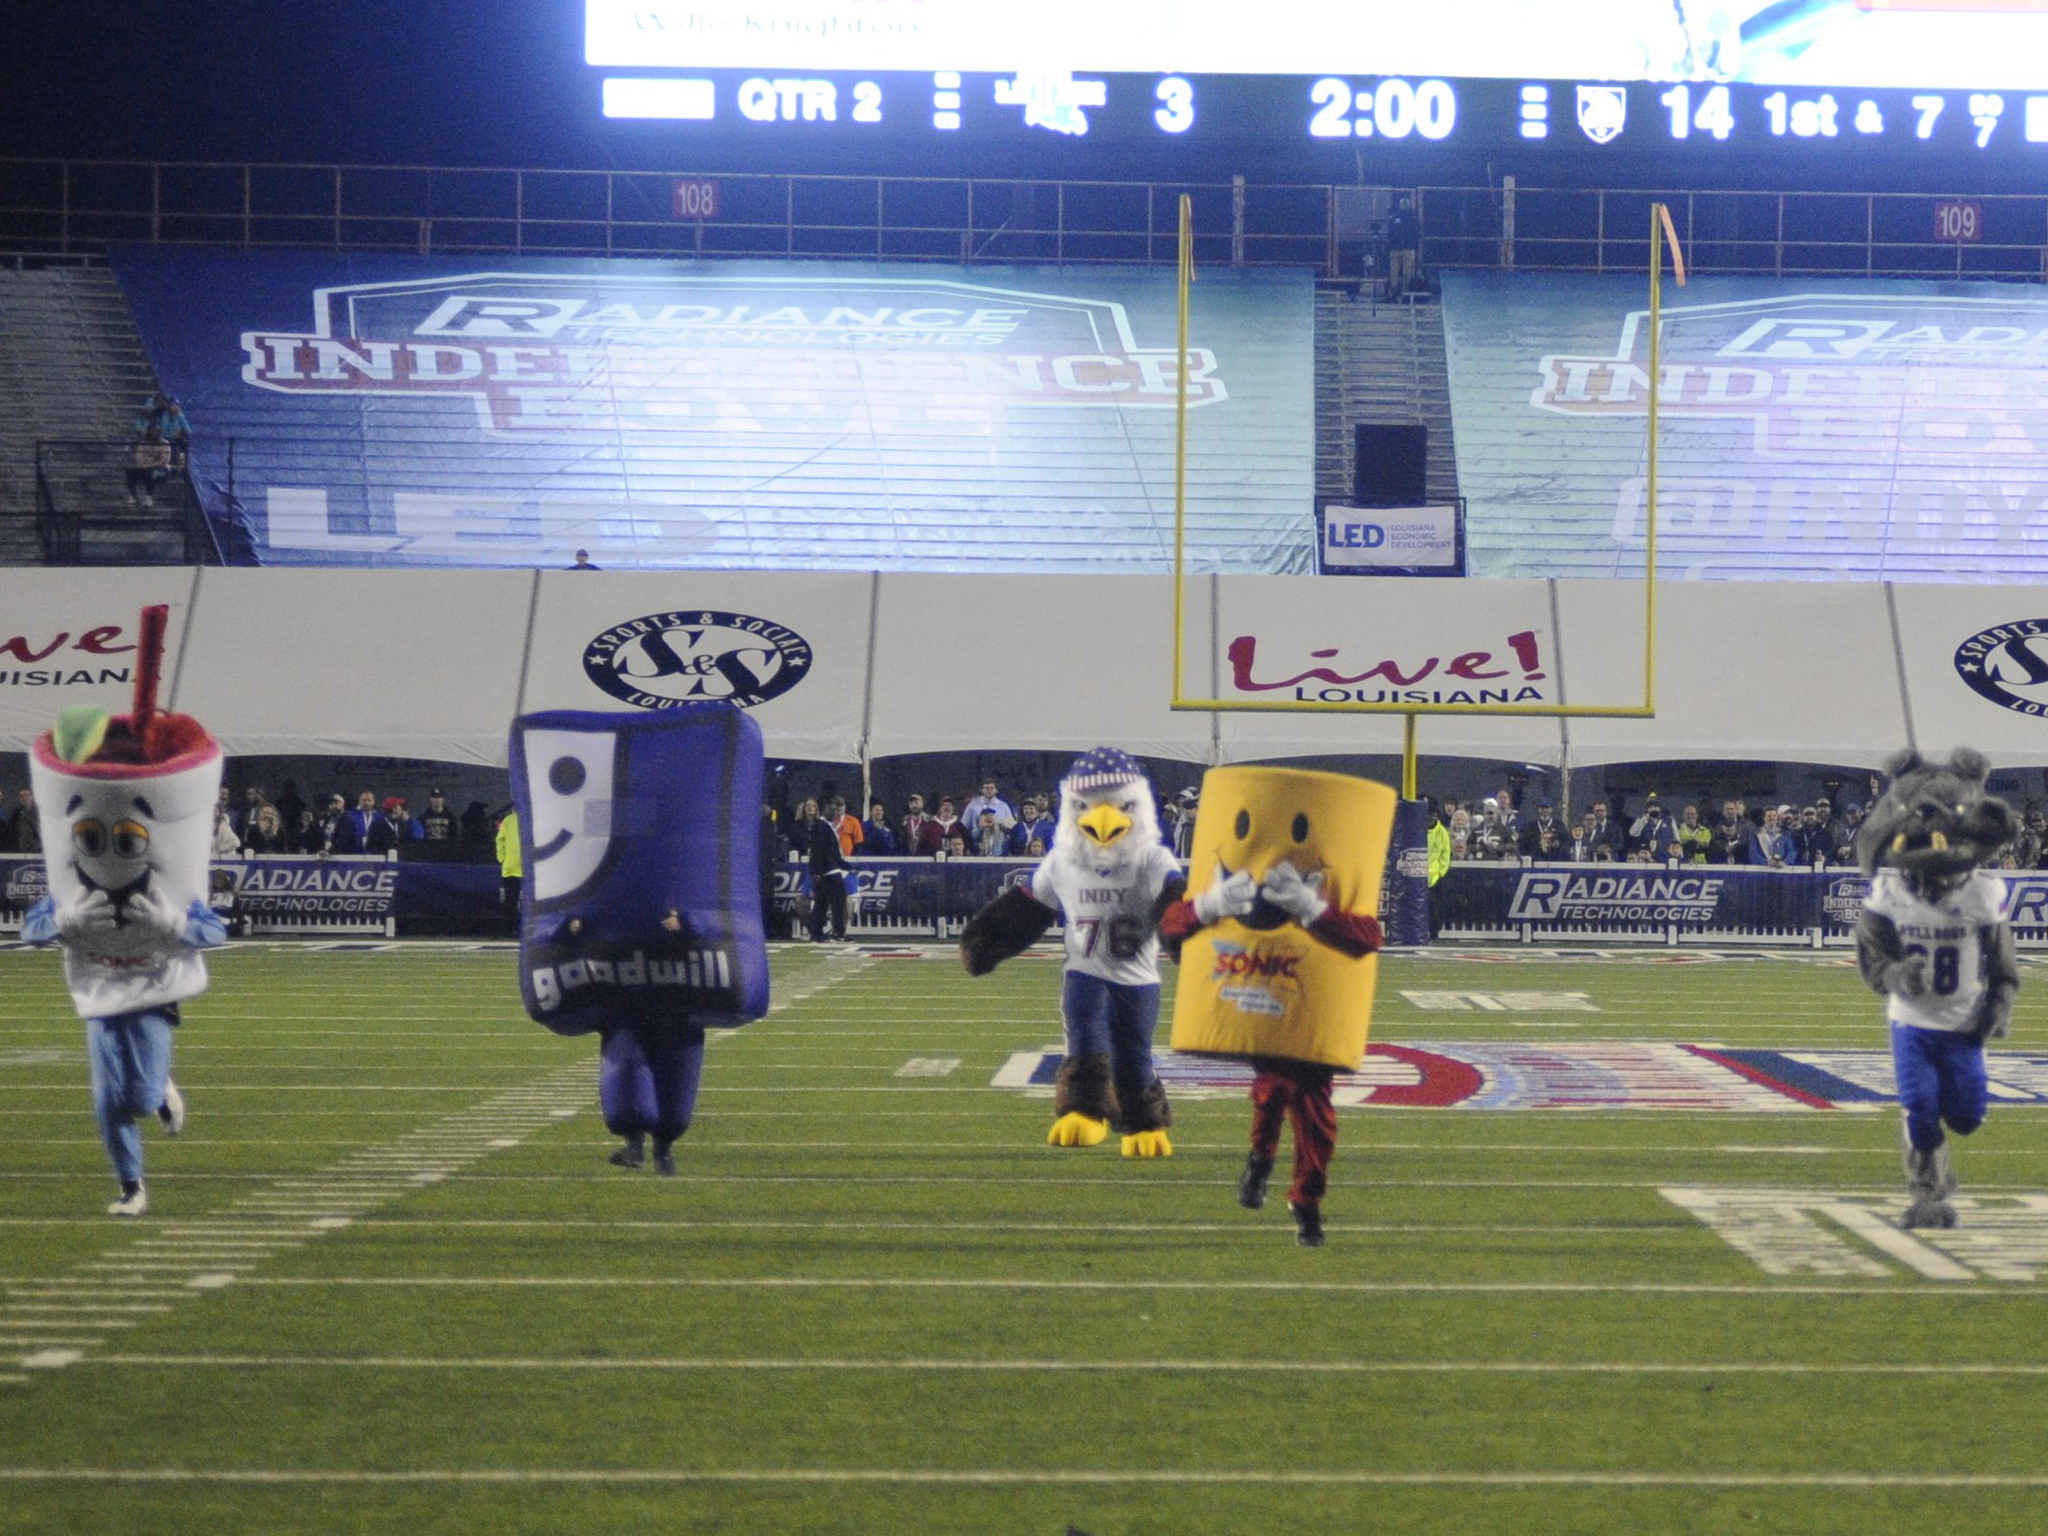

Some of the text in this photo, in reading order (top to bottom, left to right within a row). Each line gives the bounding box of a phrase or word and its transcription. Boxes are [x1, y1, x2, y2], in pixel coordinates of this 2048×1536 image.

[738, 77, 1944, 139] QTR 2 3 2:00 14 1st & 7
[1974, 116, 1997, 148] 7
[678, 183, 714, 215] 108
[1940, 206, 1976, 237] 109
[414, 296, 1030, 338] RADIANCE
[561, 325, 1007, 346] TECHNOLOGIES
[264, 336, 1204, 395] INDEPENDENCE
[267, 487, 721, 562] LED
[1328, 523, 1385, 548] LED
[1390, 524, 1436, 532] LOUISIANA
[1390, 541, 1451, 549] DEVELOPMENT
[593, 612, 808, 655] SPORTS & SOCIAL
[1961, 621, 2041, 659] SPORTS
[1228, 631, 1546, 690] Live!
[1295, 687, 1544, 704] LOUISIANA
[238, 897, 388, 912] TECHNOLOGIES
[1079, 888, 1128, 903] INDY
[1509, 873, 1724, 918] RADIANCE
[1561, 905, 1714, 921] TECHNOLOGIES
[1076, 916, 1144, 961] 76
[532, 950, 731, 1012] goodwill
[1213, 953, 1301, 978] SONIC
